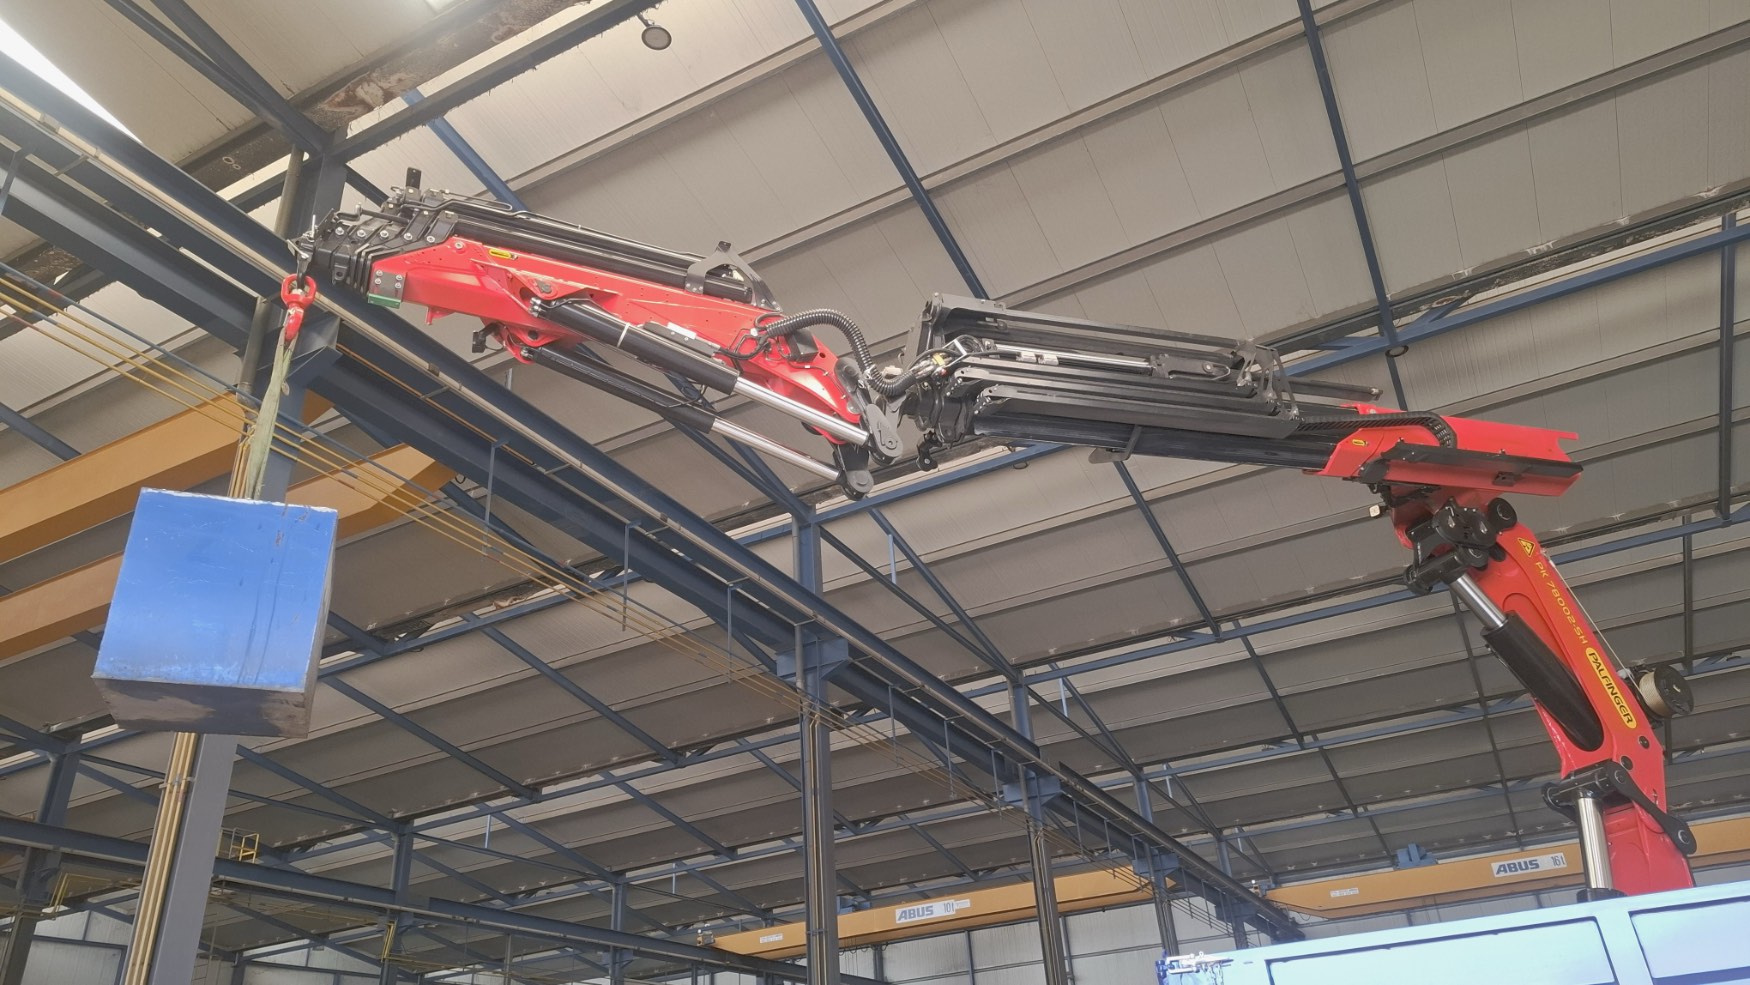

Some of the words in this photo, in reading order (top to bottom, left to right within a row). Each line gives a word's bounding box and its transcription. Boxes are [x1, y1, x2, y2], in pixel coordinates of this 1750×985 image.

[1535, 561, 1549, 578] PK
[1589, 652, 1633, 724] PALFINGER
[1496, 859, 1540, 875] ABUS
[898, 905, 933, 921] ABUS
